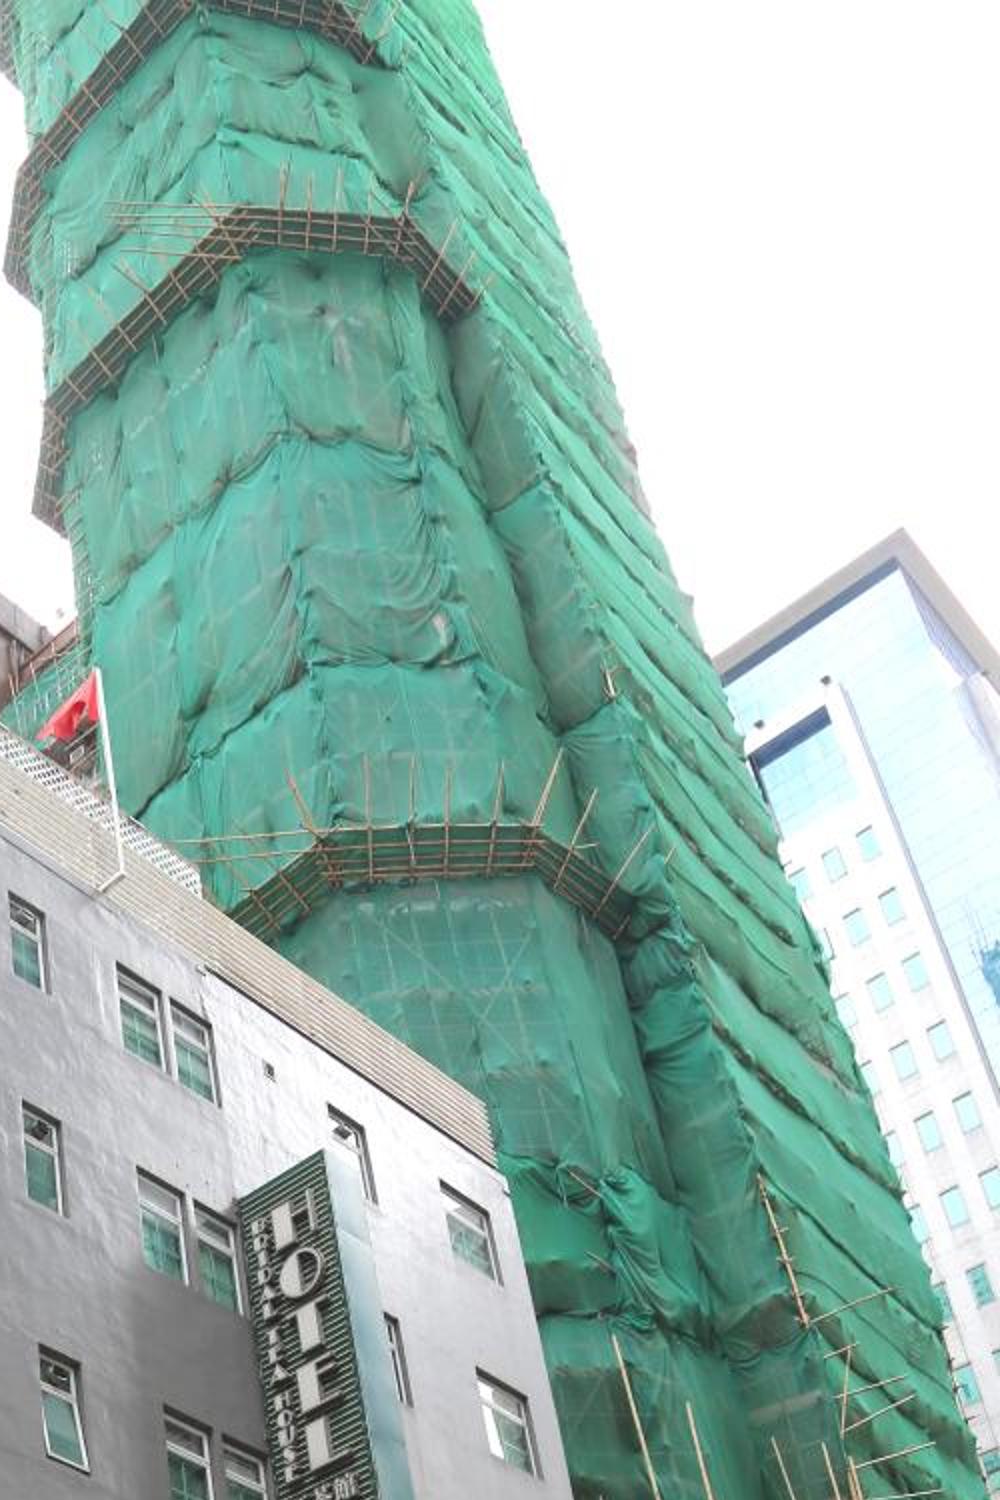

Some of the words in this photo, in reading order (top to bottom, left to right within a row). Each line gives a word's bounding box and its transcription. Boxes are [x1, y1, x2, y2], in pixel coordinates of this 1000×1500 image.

[251, 1217, 283, 1320] BRIDAL
[267, 1325, 290, 1386] TEA
[271, 1187, 355, 1472] HOTEL
[274, 1391, 302, 1483] HOUSE
